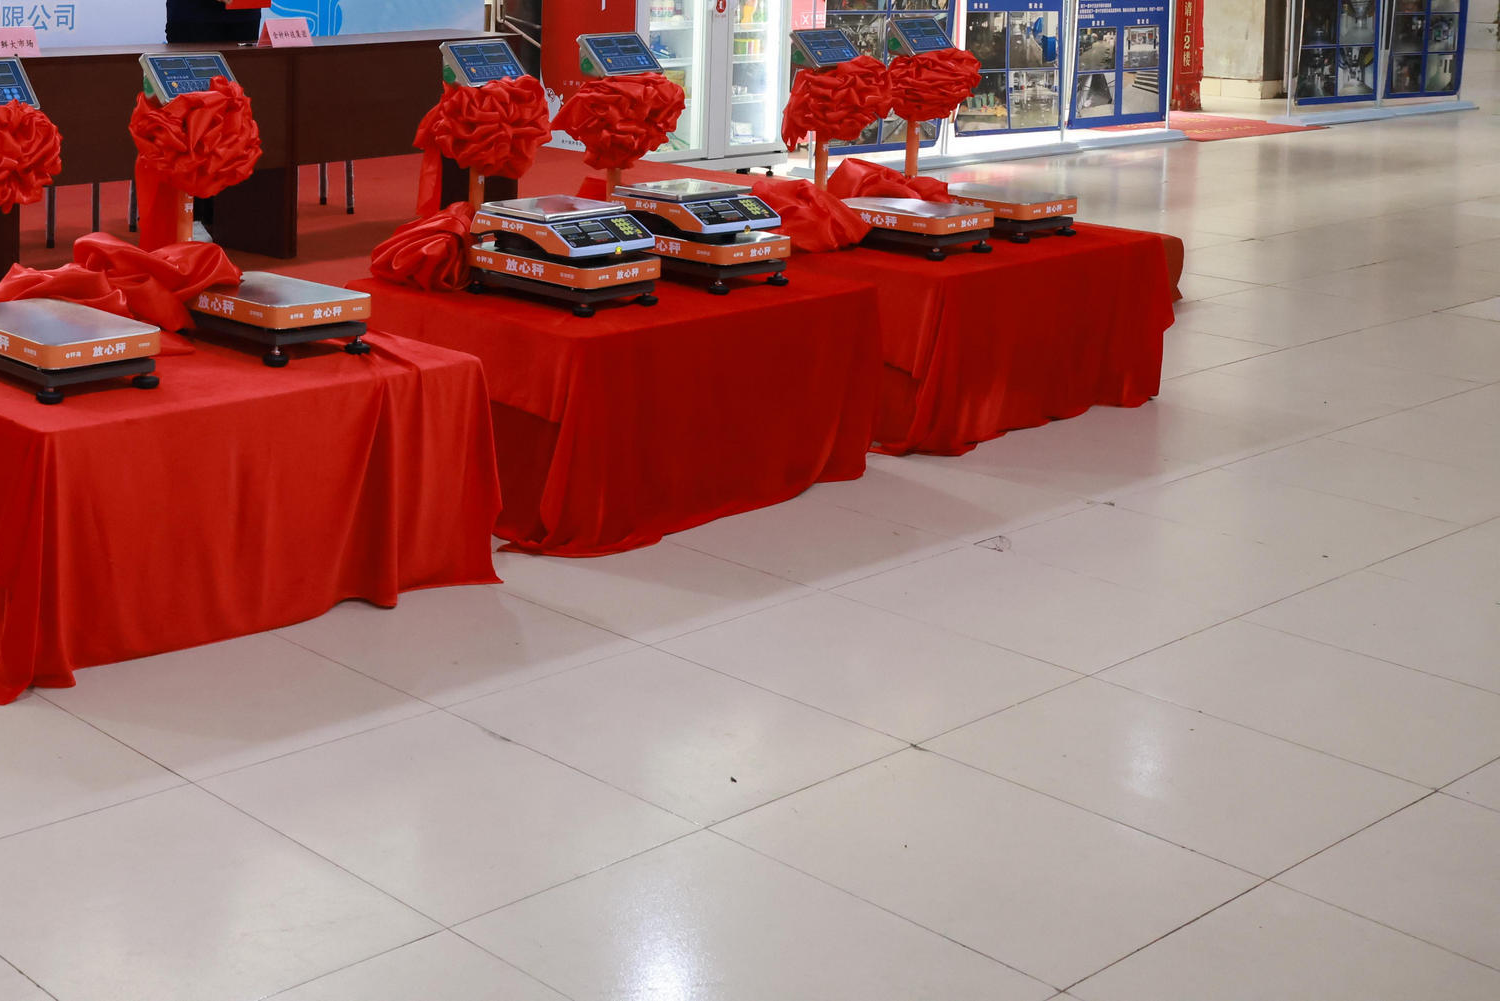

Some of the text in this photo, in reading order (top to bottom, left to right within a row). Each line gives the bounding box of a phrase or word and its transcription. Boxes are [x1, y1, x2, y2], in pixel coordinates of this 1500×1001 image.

[501, 220, 524, 232] 放心秤
[653, 240, 682, 256] 心秤
[750, 245, 771, 258] 放心秤
[505, 258, 545, 277] 放心秤
[615, 267, 639, 281] 放心秤
[197, 294, 235, 316] 放心秤
[313, 305, 343, 319] 放心秤
[92, 342, 127, 358] 放心秤
